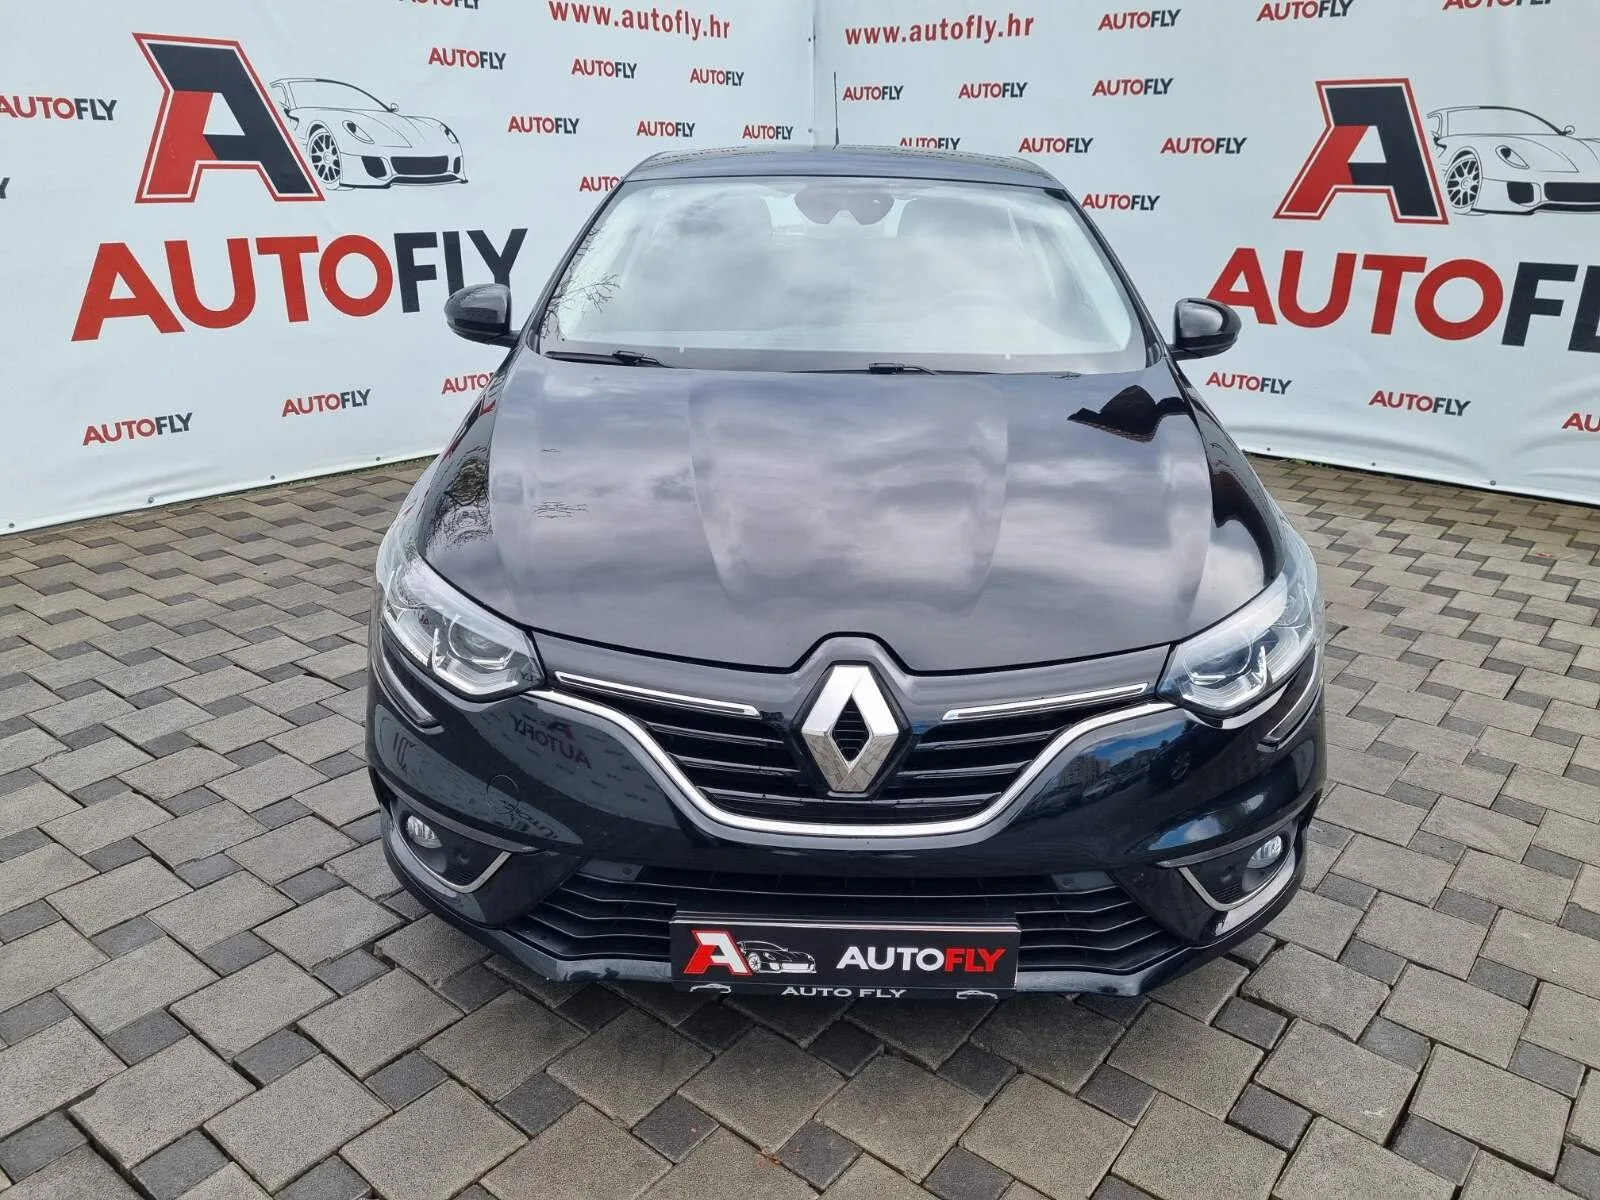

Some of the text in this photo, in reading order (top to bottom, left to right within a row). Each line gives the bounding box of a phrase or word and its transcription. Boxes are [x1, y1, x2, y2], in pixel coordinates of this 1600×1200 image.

[1098, 9, 1181, 30] AUTOFLY
[1256, 0, 1354, 21] AUTOFLY
[549, 1, 730, 41] www.autofly.hr
[845, 13, 1034, 45] www.autofly.hr
[428, 47, 507, 70] AUTOFLY
[571, 59, 637, 79] AUTOFLY
[690, 68, 744, 87] AUTOFLY
[843, 85, 904, 101] AUTOFLY
[958, 82, 1028, 99] AUTOFLY
[1092, 78, 1173, 96] AUTOFLY
[508, 116, 580, 135] AUTOFLY
[636, 121, 695, 138] AUTOFLY
[742, 125, 793, 140] AUTOFLY
[1018, 137, 1093, 153] AUTOFLY
[1160, 137, 1247, 154] AUTOFLY
[1082, 193, 1160, 211] AUTOFLY
[71, 228, 528, 341] AUTOFLY
[442, 372, 494, 395] AUTO
[1206, 371, 1292, 395] AUTOFLY
[282, 389, 371, 417] AUTOFLY
[1369, 390, 1471, 416] AUTOFLY
[83, 412, 193, 446] AUTOFLY
[836, 946, 1006, 972] AUTOFLY
[781, 986, 907, 999] AUTO FLY
